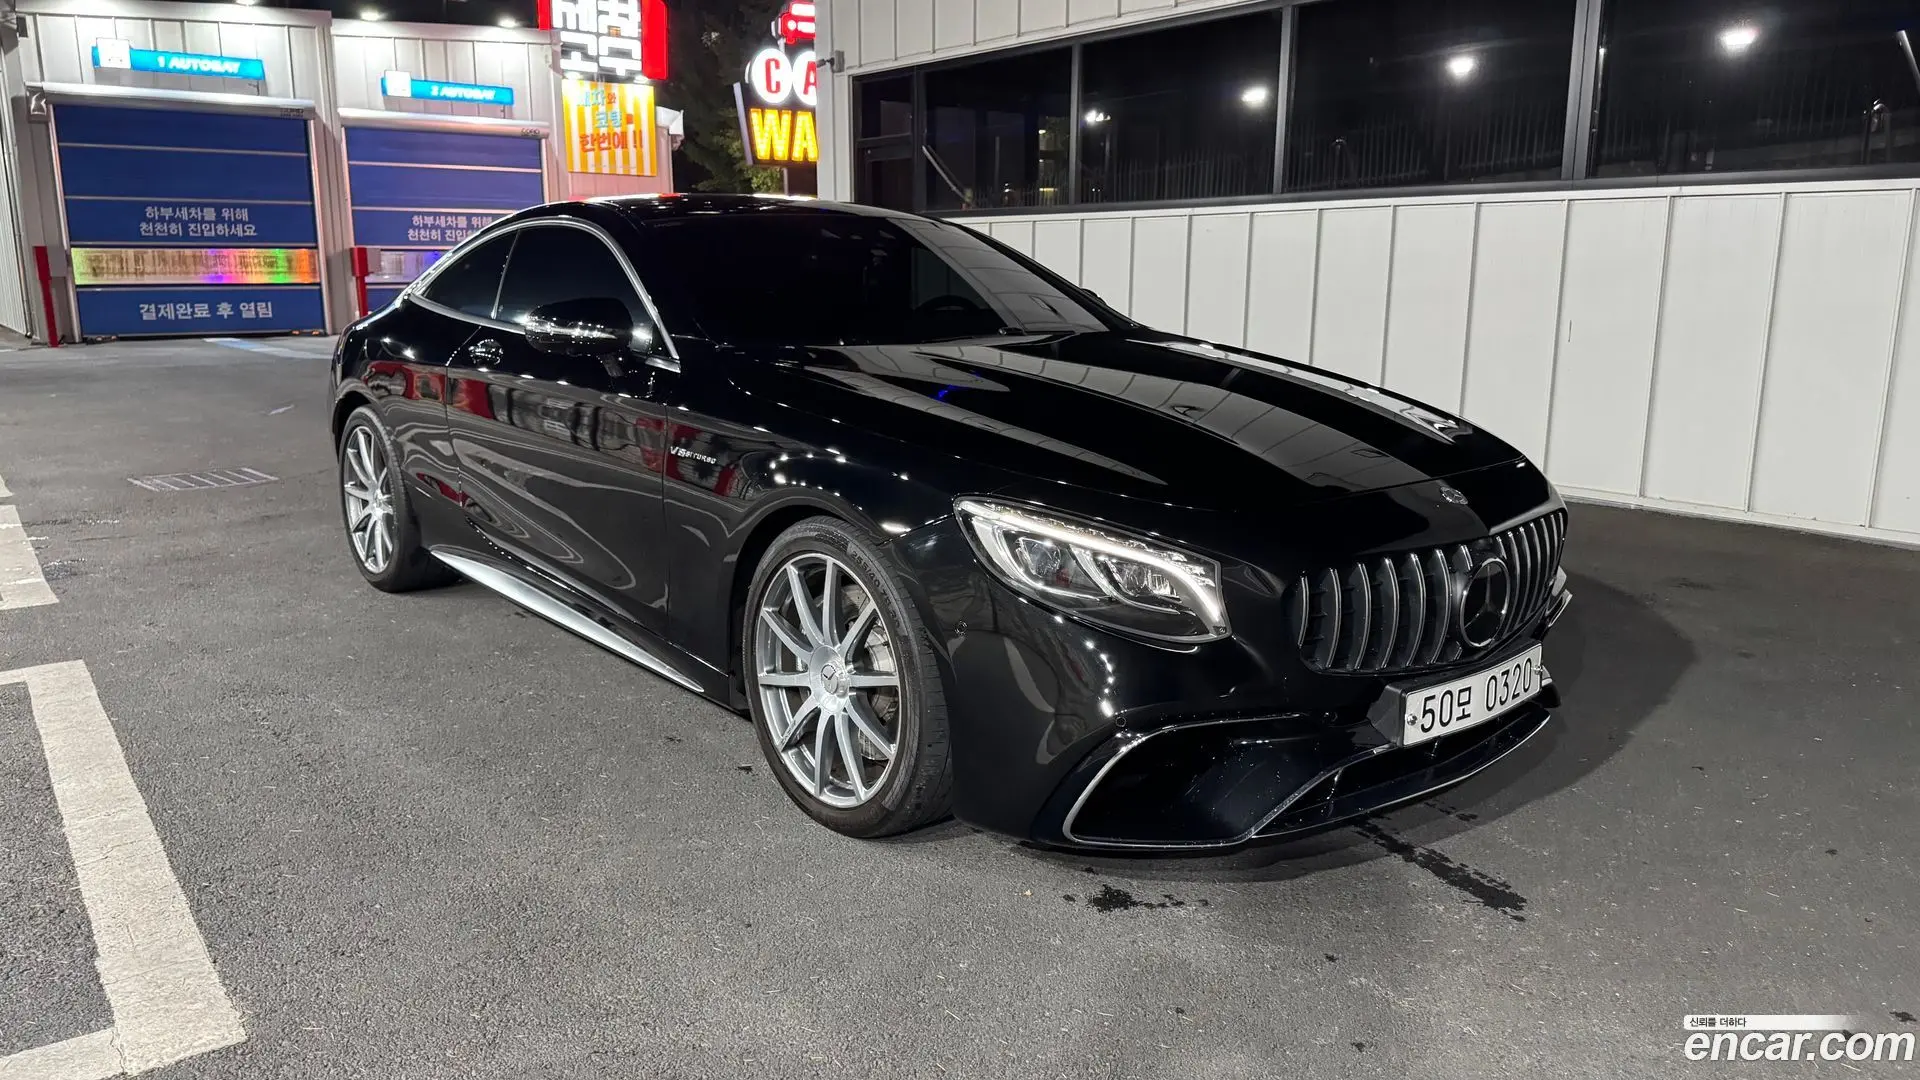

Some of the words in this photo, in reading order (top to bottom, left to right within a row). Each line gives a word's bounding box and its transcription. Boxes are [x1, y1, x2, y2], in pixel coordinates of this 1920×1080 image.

[157, 56, 166, 68] 1
[750, 108, 819, 162] WA
[145, 206, 216, 221] 하부세차를
[221, 208, 249, 222] 위해
[140, 222, 182, 237] 천천히
[188, 223, 258, 237] 진입하세요
[412, 215, 467, 229] 하부세차를
[408, 229, 441, 241] 천천히
[139, 302, 211, 320] 결제완료
[216, 302, 234, 319] 후
[240, 302, 273, 319] 열림
[1420, 686, 1472, 733] 50모
[1485, 657, 1532, 712] 0320
